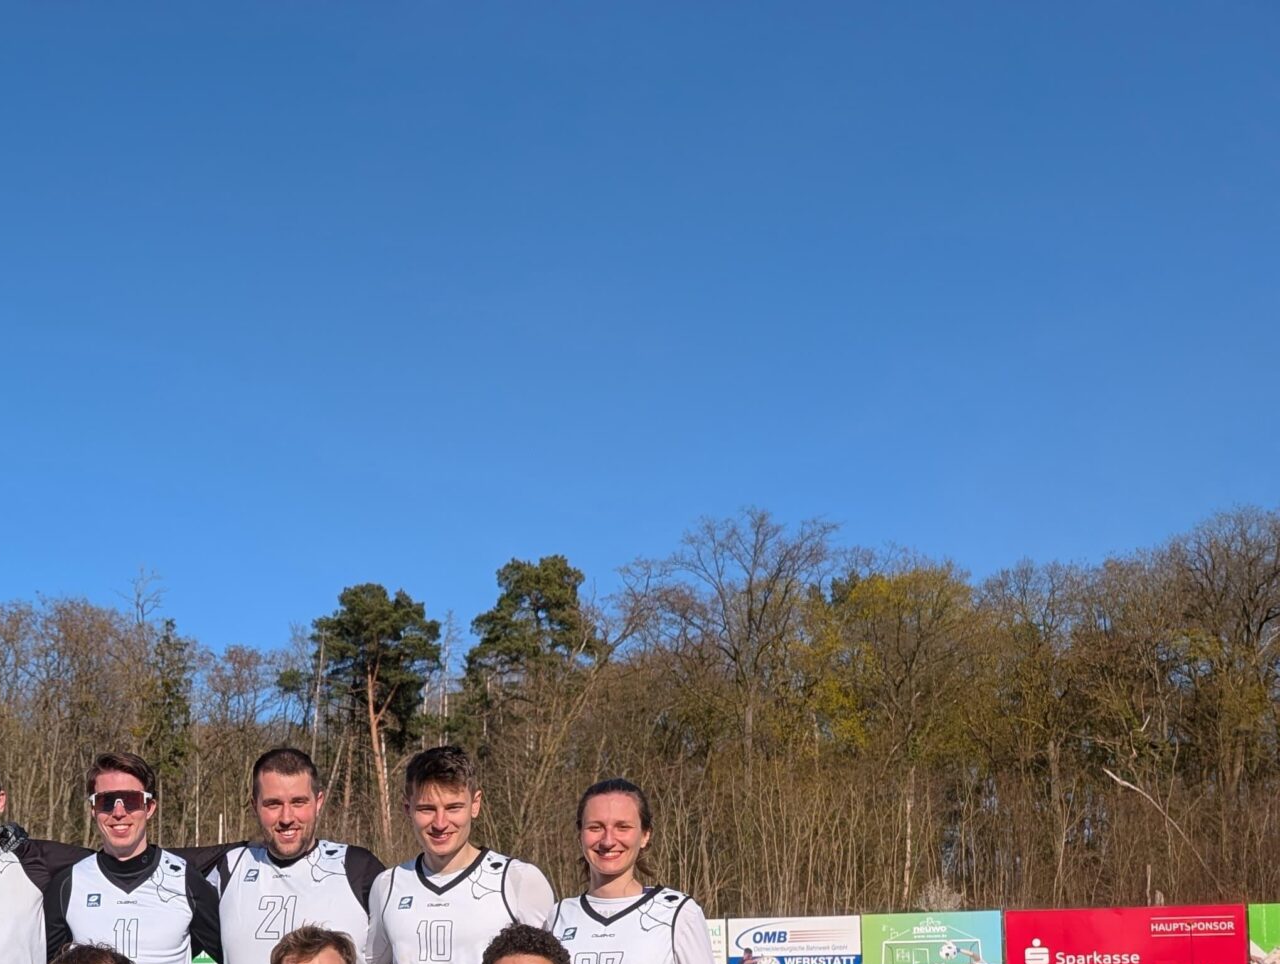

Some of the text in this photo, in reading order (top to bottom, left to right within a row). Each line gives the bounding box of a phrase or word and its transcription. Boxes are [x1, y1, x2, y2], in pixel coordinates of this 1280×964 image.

[255, 895, 298, 940] 21
[752, 930, 788, 944] OMB
[1150, 921, 1236, 933] HAUPTSPONSOR
[113, 918, 138, 958] 11
[416, 920, 453, 961] 10
